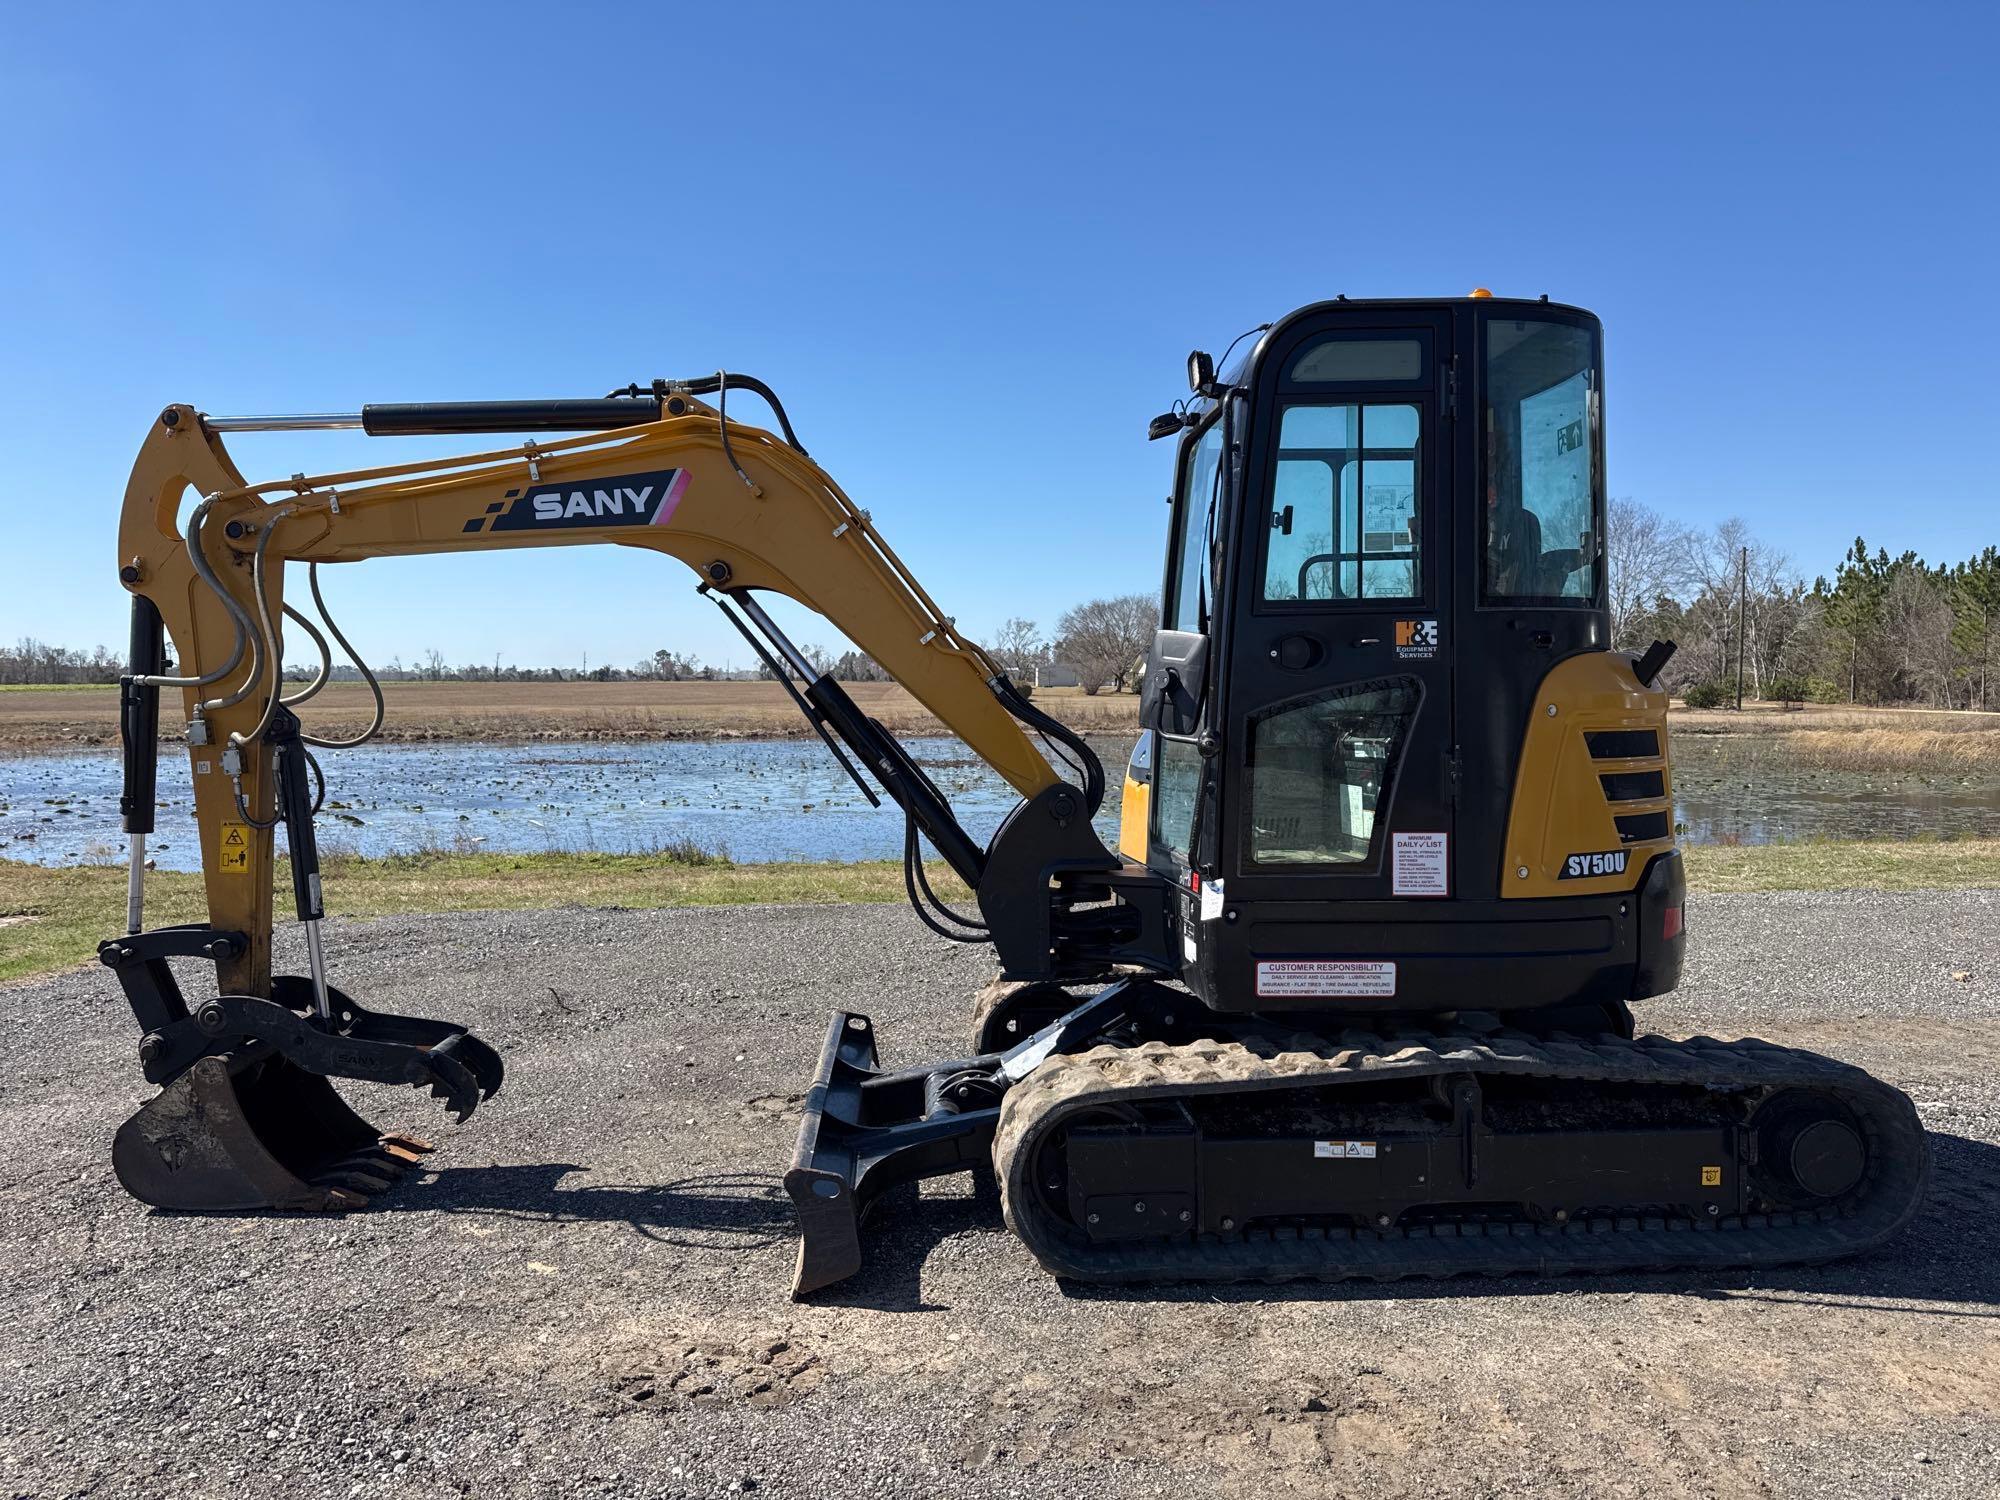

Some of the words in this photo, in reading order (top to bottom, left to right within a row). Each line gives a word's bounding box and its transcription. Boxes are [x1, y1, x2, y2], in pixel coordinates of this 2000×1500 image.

[533, 486, 654, 520] SANY
[1396, 621, 1438, 646] H&E
[1568, 852, 1625, 876] SY50U
